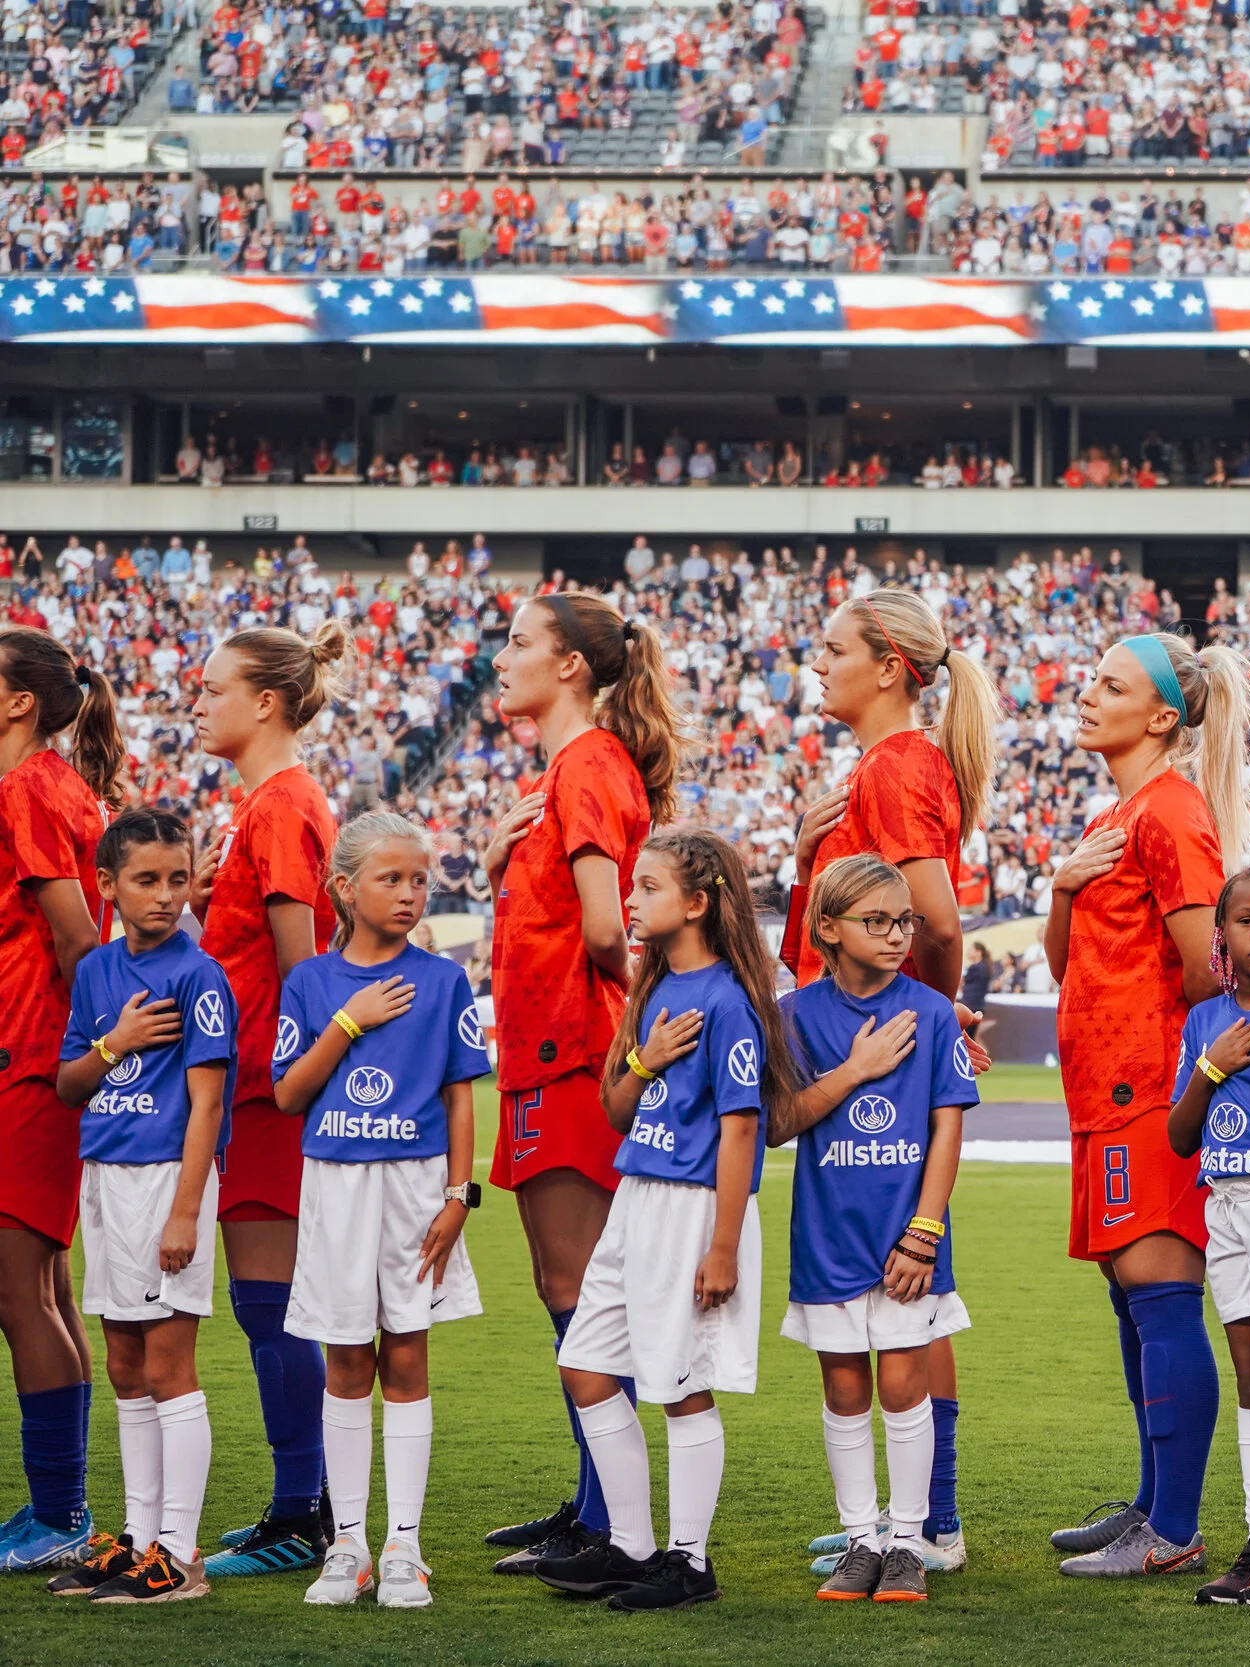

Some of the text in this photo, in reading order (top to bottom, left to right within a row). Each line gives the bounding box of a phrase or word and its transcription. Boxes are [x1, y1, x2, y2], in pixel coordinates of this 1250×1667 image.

[248, 516, 274, 529] 122
[513, 1089, 542, 1141] 12
[1104, 1145, 1131, 1206] 8
